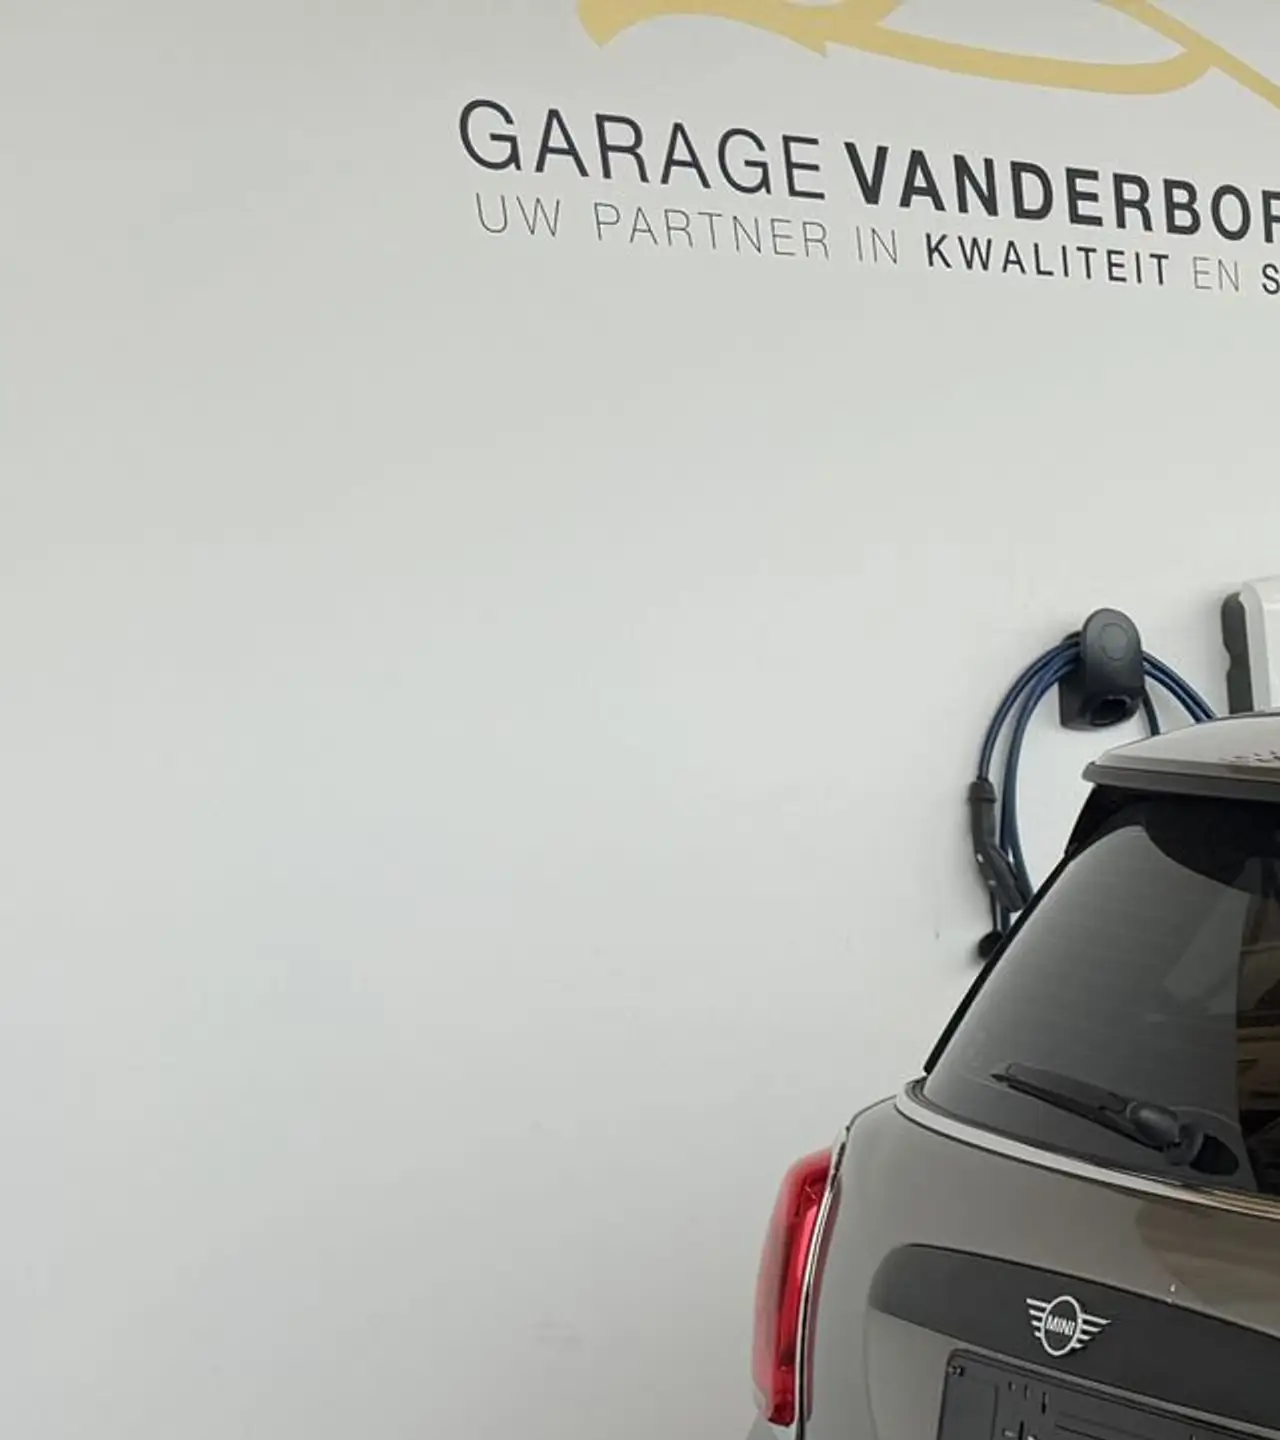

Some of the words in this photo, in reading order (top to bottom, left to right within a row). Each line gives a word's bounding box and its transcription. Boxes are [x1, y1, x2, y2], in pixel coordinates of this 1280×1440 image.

[458, 98, 826, 200] GARAGE
[475, 191, 562, 239] UW
[594, 202, 830, 261] PARTNER
[856, 226, 898, 265] IN
[925, 232, 1169, 287] KWALITEIT
[1192, 256, 1242, 293] EN
[1045, 1314, 1076, 1336] MINI
